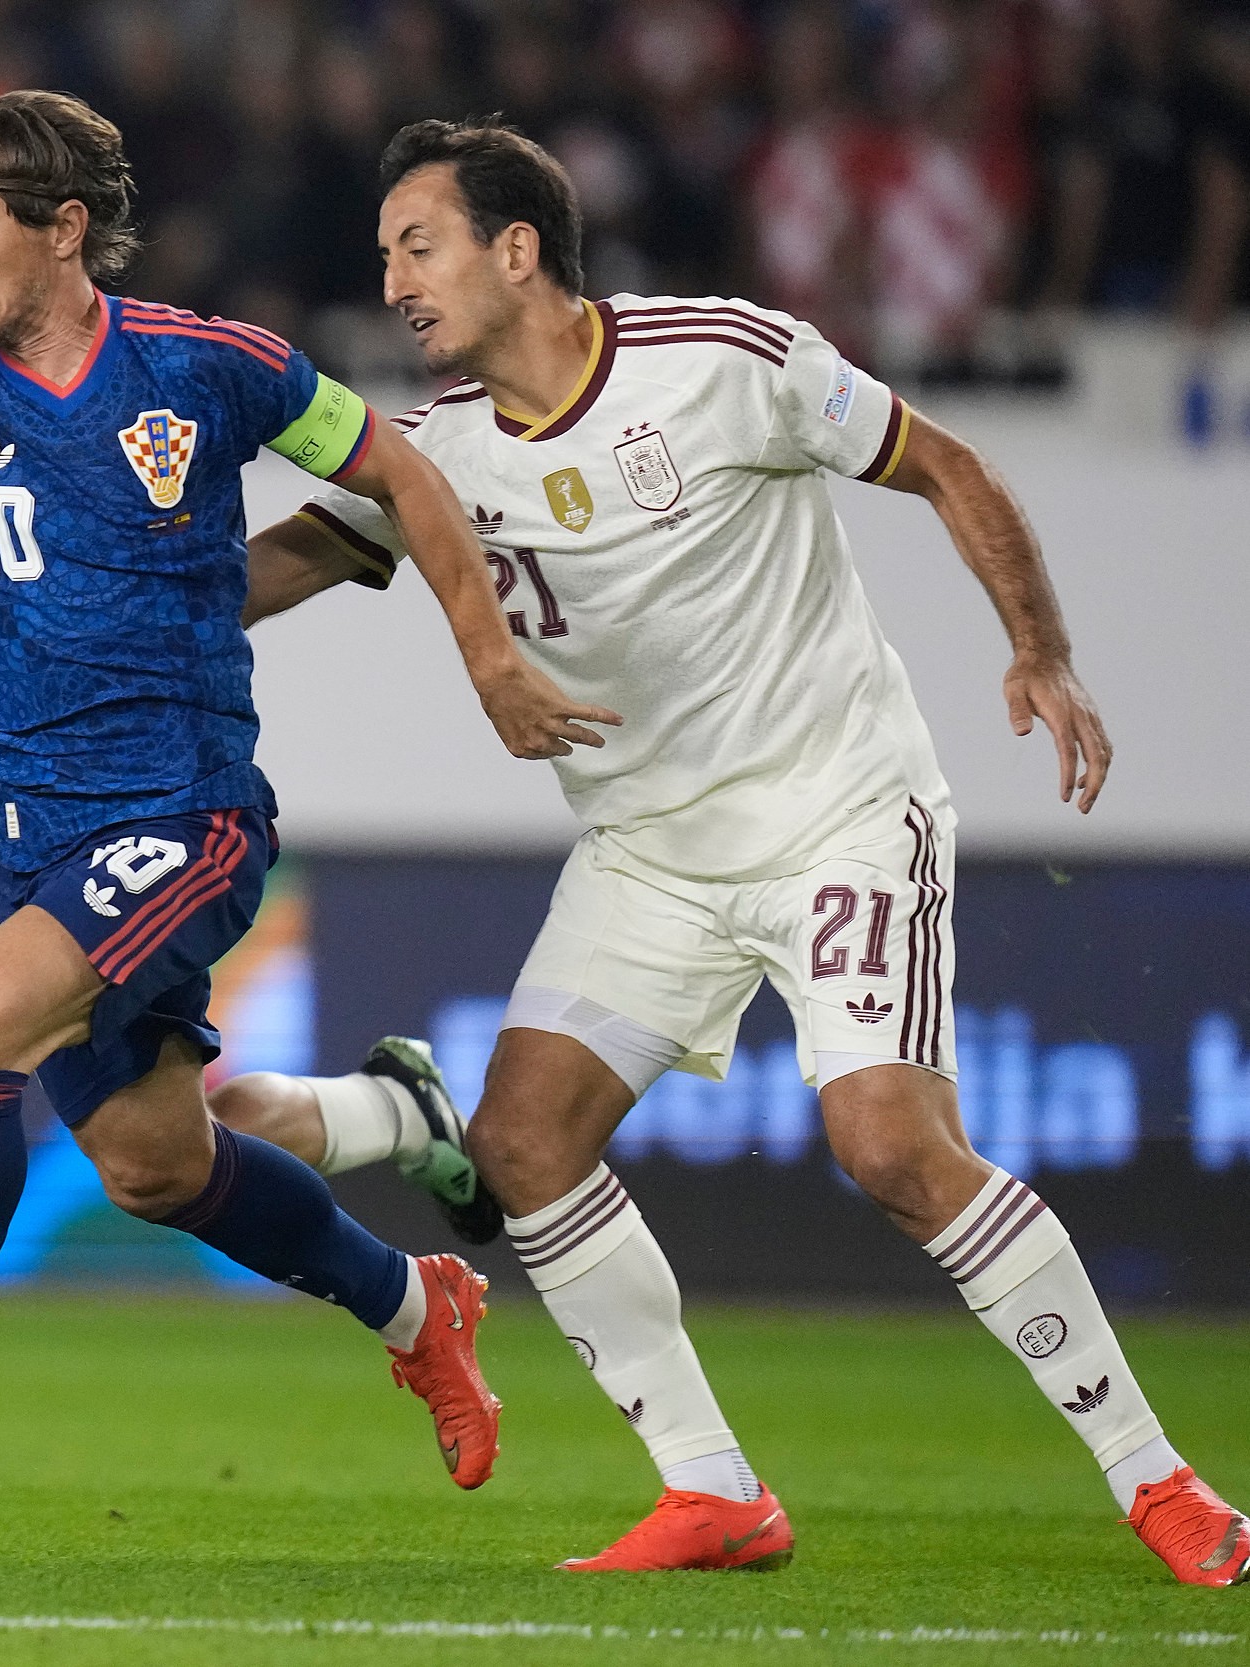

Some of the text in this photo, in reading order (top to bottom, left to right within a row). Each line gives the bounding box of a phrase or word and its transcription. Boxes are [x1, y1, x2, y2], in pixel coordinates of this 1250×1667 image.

[152, 421, 168, 469] HNS
[483, 547, 569, 640] 21
[811, 884, 895, 981] 21
